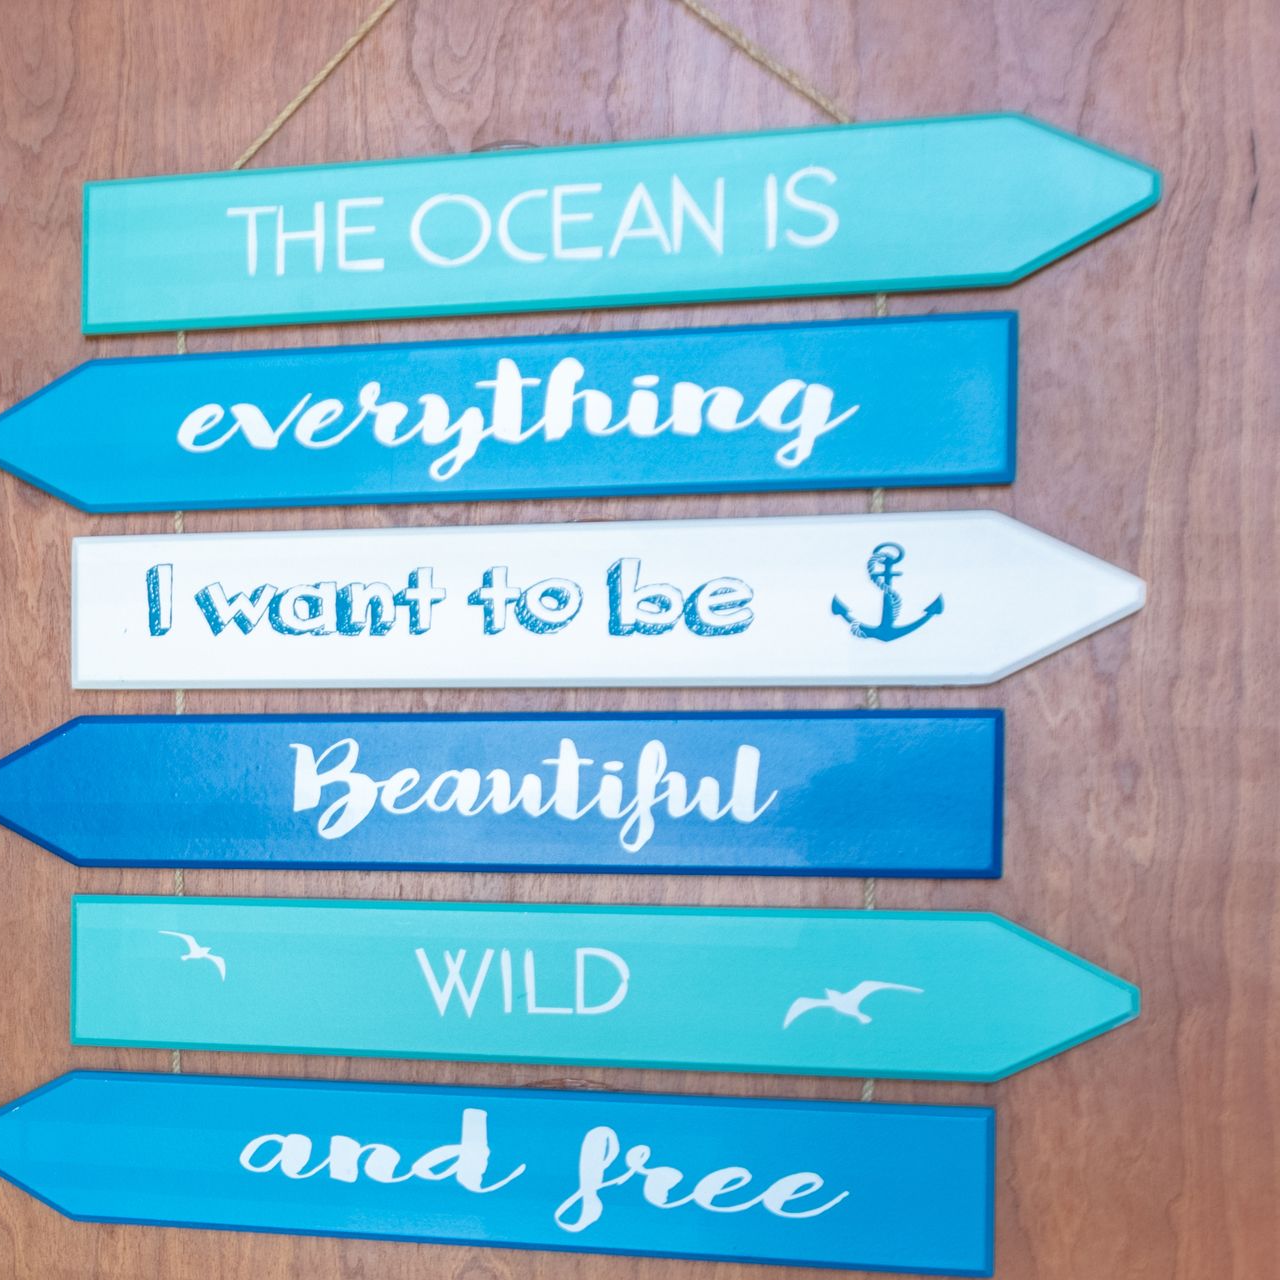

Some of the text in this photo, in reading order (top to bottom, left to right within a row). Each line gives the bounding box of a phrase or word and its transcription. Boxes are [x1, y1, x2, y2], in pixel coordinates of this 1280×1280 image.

[226, 165, 840, 277] THE OCEAN IS
[175, 355, 860, 483] everything
[145, 556, 755, 639] I want to be
[288, 736, 780, 854] Beautiful
[414, 946, 631, 1017] WILD
[239, 1107, 850, 1234] and free
